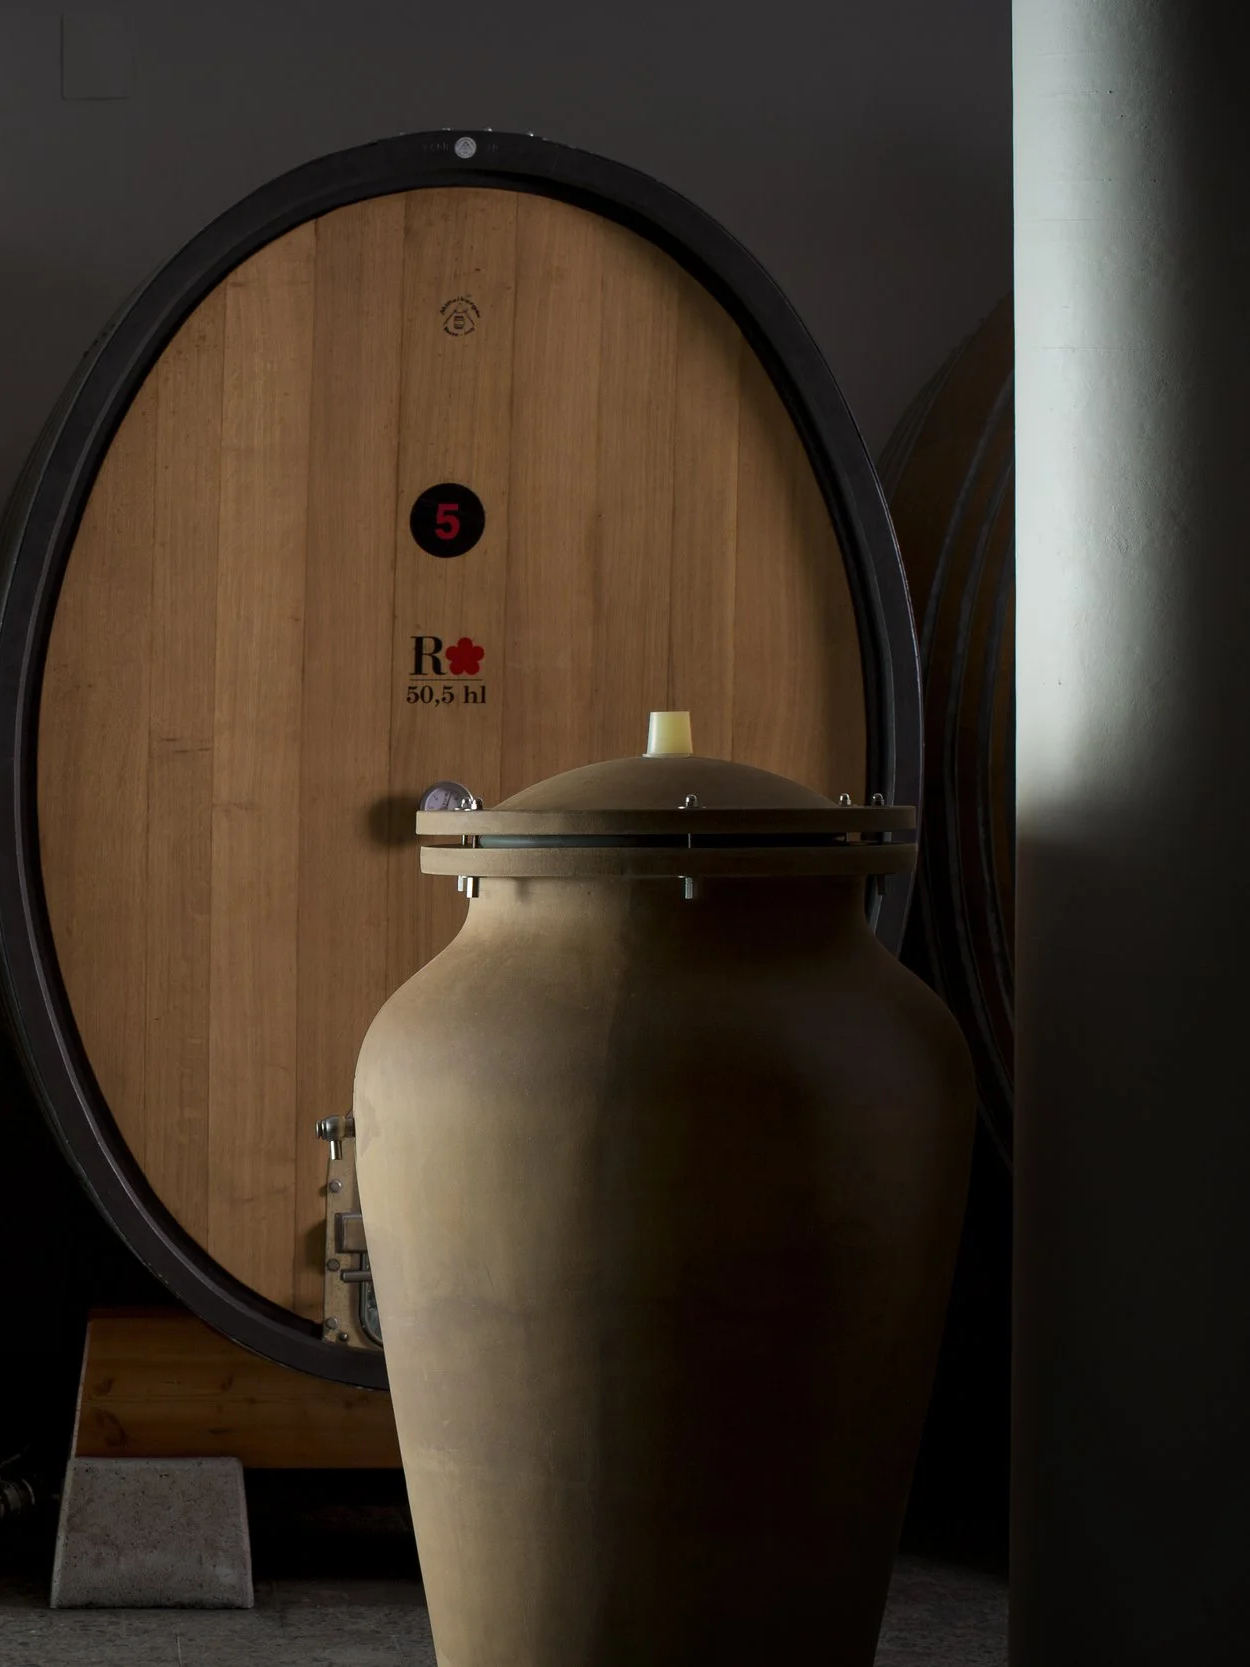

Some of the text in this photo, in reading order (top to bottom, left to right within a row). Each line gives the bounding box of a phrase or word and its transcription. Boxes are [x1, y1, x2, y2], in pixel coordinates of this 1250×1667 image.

[434, 503, 461, 540] 5
[409, 635, 447, 675] R
[406, 684, 487, 707] 50,5 hl
